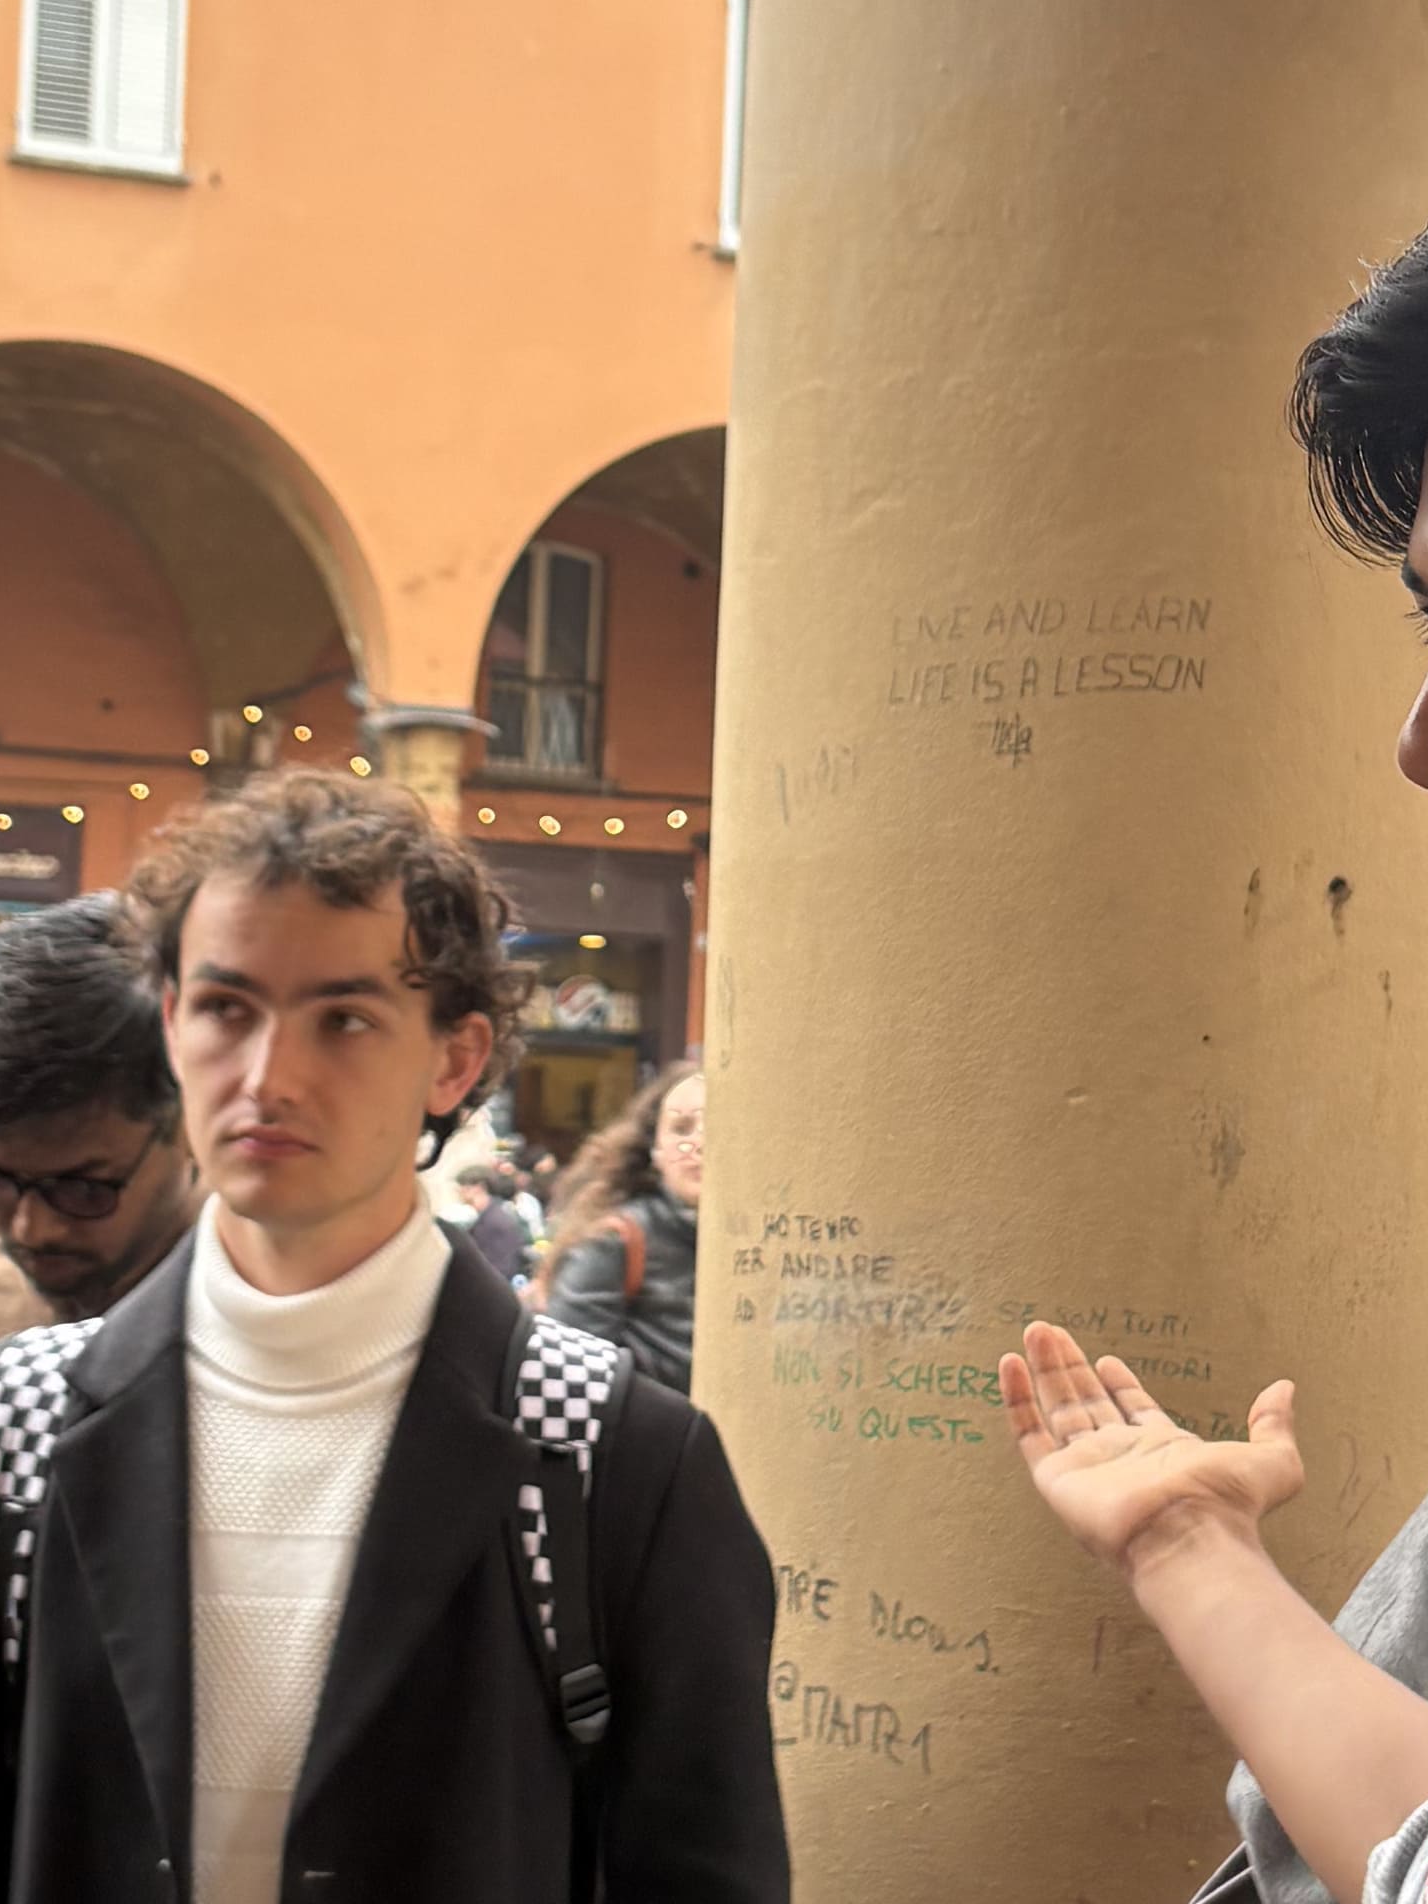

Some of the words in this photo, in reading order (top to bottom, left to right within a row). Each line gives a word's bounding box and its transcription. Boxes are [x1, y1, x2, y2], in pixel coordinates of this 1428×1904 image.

[891, 604, 971, 644] LIVE
[983, 597, 1067, 639] AND
[1086, 596, 1213, 635] LEARN
[888, 661, 958, 705] LIFE
[972, 659, 1005, 704] IS
[1019, 655, 1039, 697] A
[1053, 652, 1206, 697] LESSON
[732, 1247, 765, 1276] PER
[780, 1251, 895, 1283] ANDARE
[879, 1357, 1005, 1407] SCHERZ
